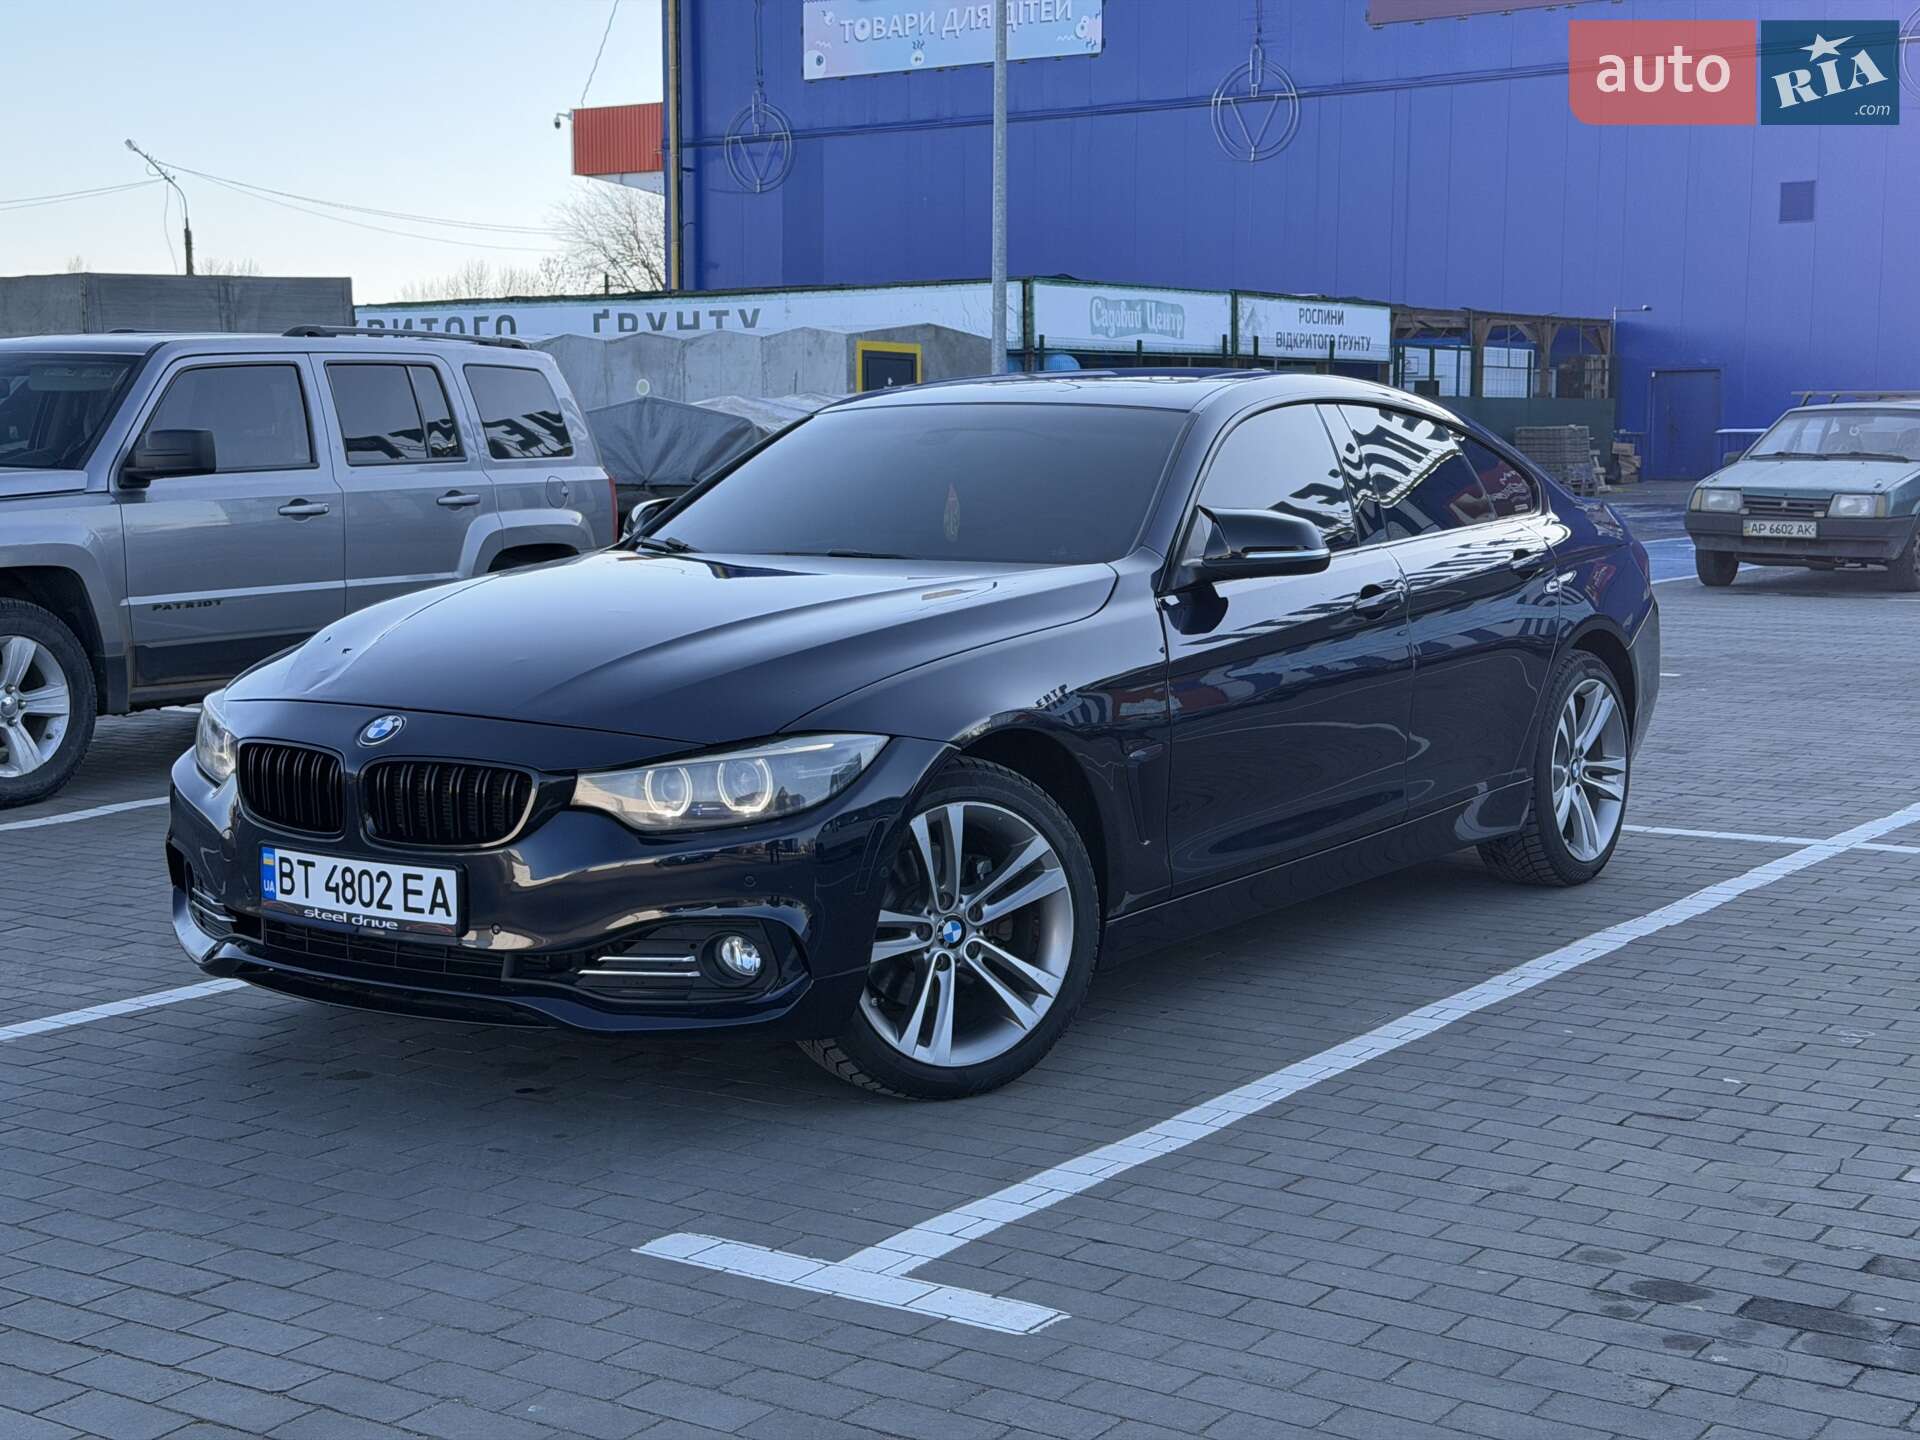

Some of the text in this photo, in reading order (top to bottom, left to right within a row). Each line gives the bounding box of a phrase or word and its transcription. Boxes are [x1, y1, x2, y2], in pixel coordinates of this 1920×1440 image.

[839, 16, 935, 43] ТОВАРИ
[941, 3, 992, 40] ДЛЯ
[354, 304, 517, 338] РИТОГО
[1298, 308, 1345, 325] РОСЛИНИ
[1751, 523, 1812, 535] AP 6602 AK
[152, 599, 224, 611] PATRIOT
[263, 880, 276, 893] UA
[278, 856, 452, 917] BT 4802 EA
[303, 908, 399, 930] steel drive
